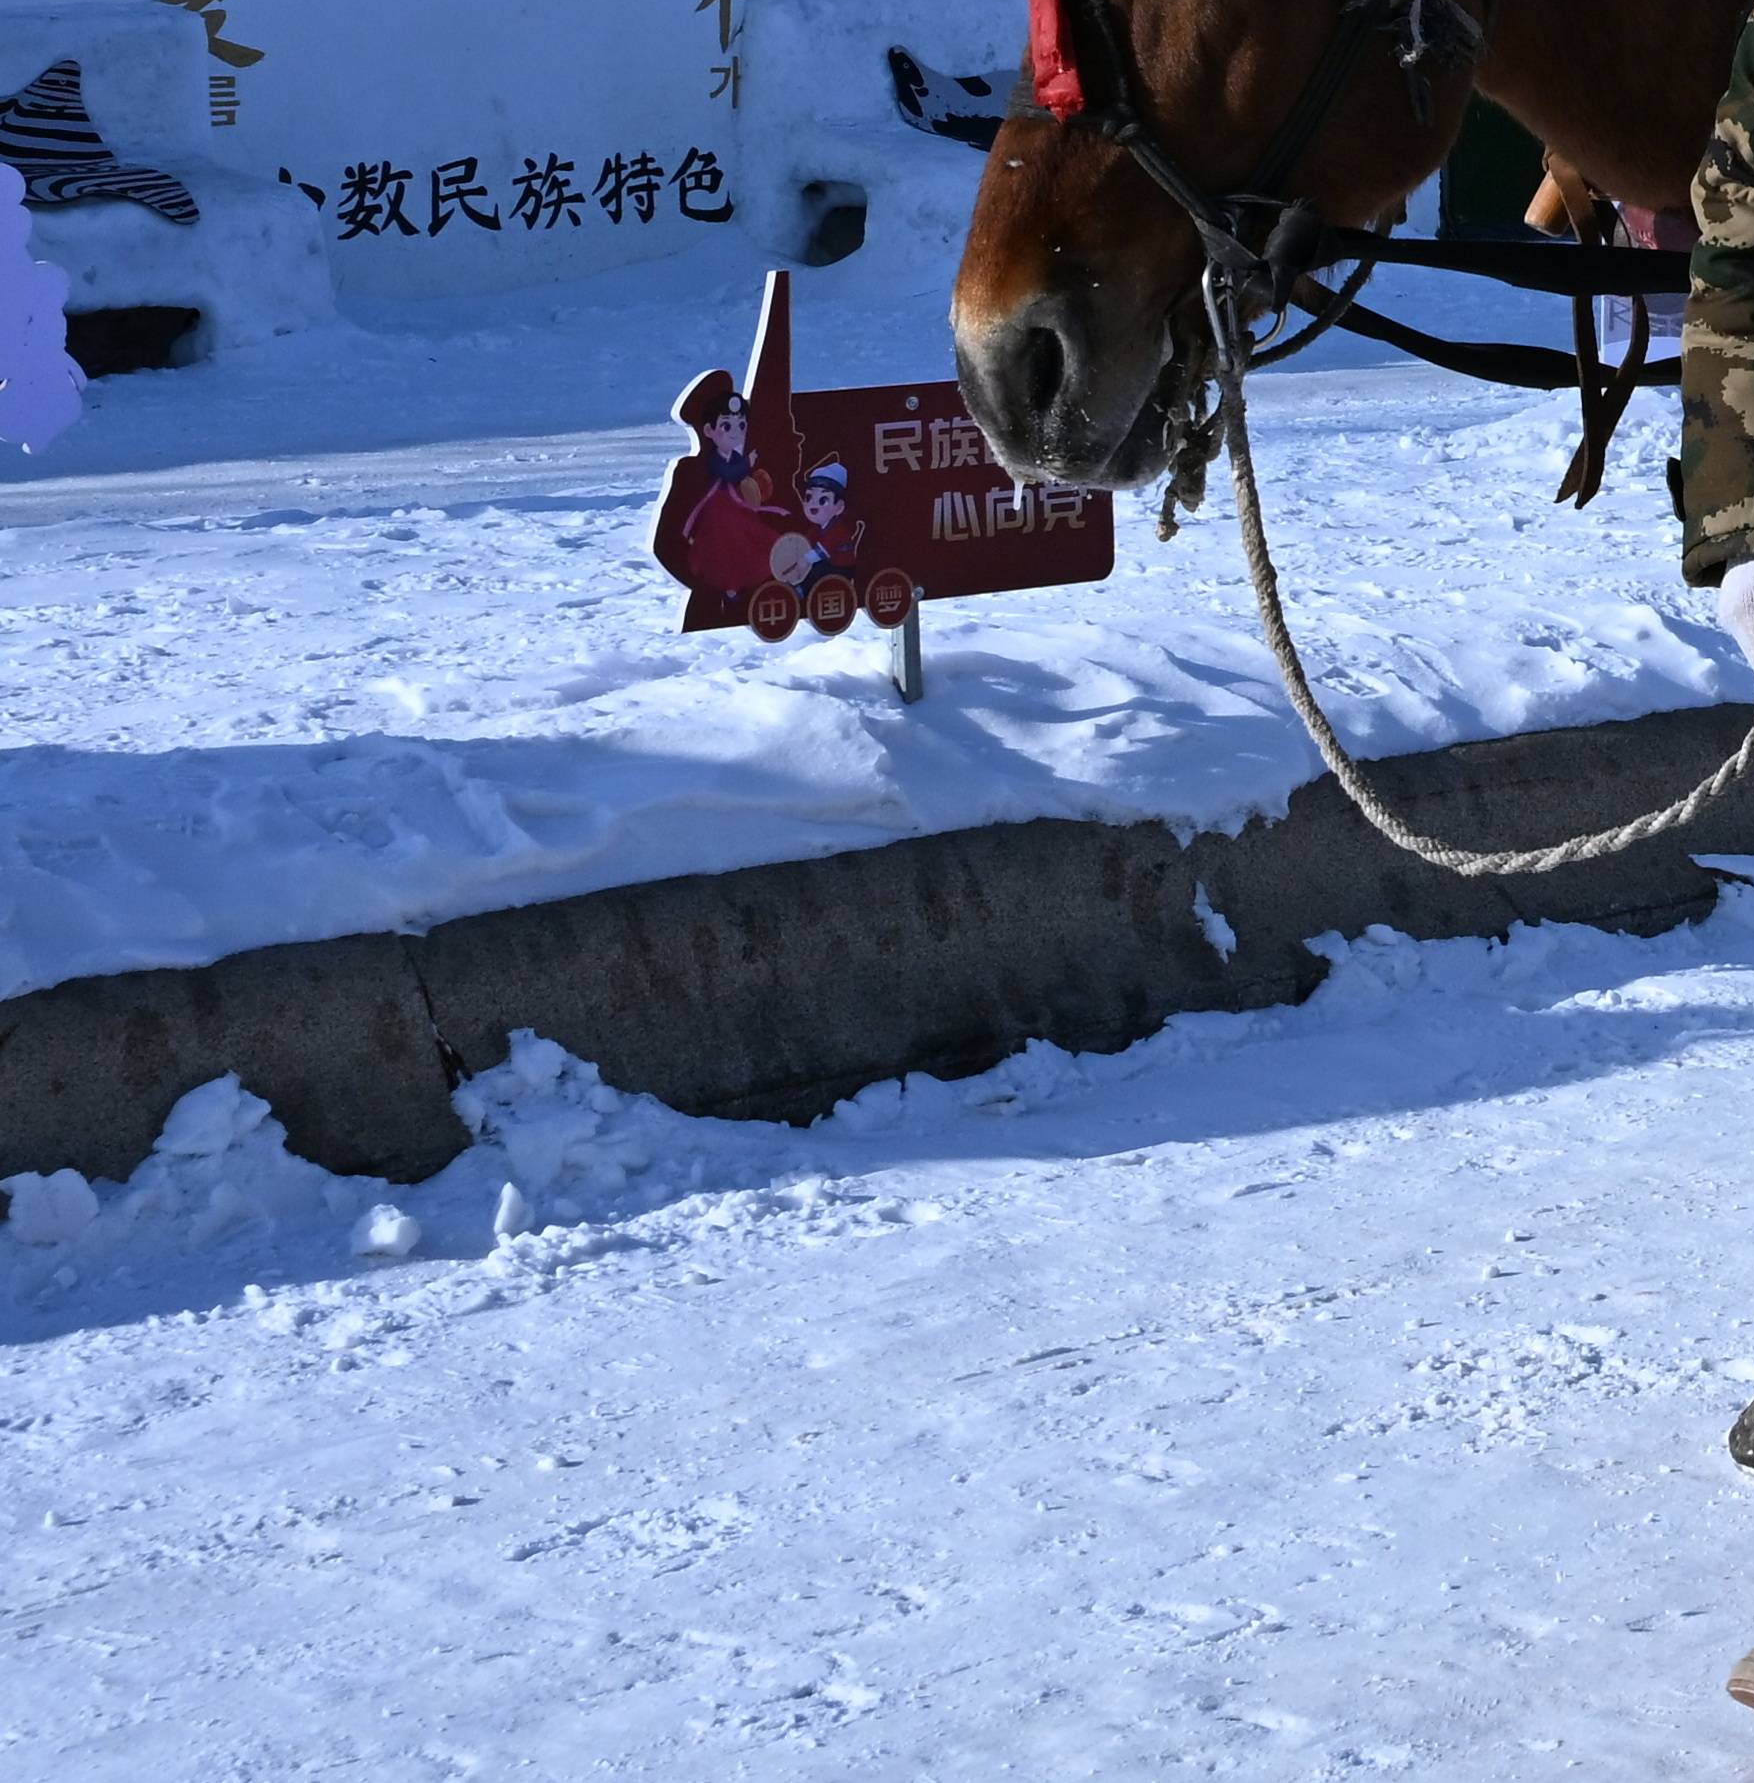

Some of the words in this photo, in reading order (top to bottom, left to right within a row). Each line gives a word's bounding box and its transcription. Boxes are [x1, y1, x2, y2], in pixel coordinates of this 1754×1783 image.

[279, 146, 735, 239] 数民族特色
[873, 416, 1002, 474] 民族
[758, 584, 903, 626] 中国梦
